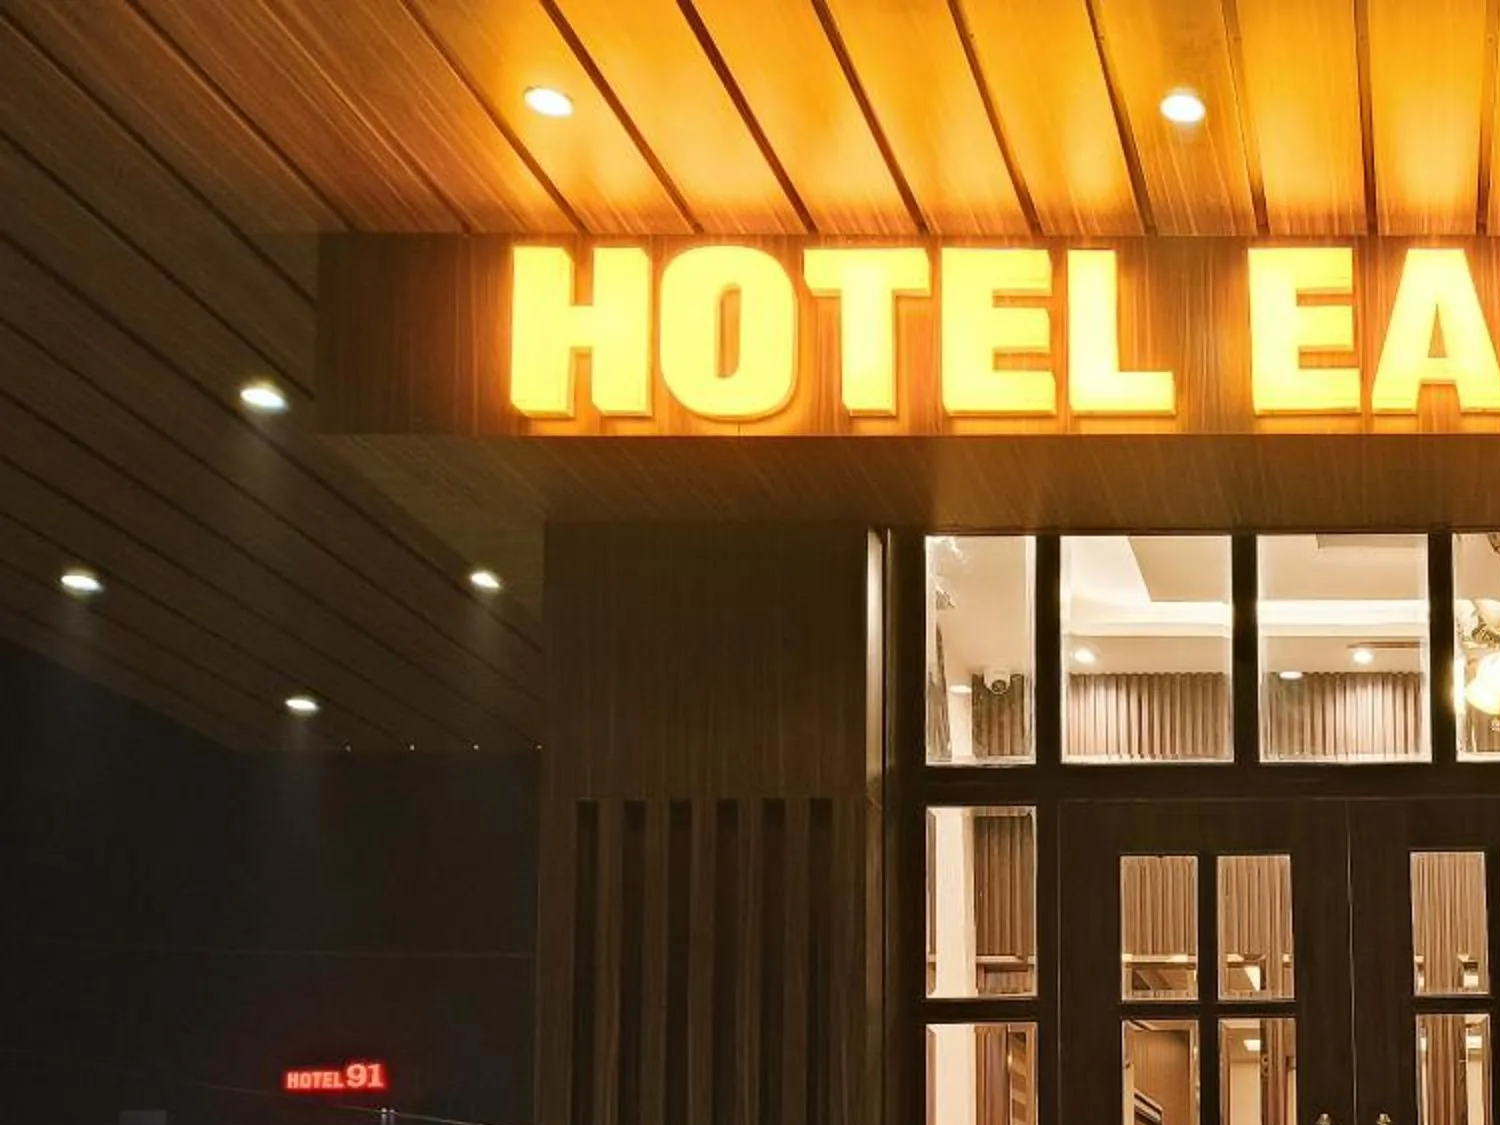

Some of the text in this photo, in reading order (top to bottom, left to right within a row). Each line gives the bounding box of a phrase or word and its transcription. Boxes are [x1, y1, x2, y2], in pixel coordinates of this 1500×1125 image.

[510, 245, 1176, 420] HOTEL
[286, 1063, 385, 1089] HOTEL 91
